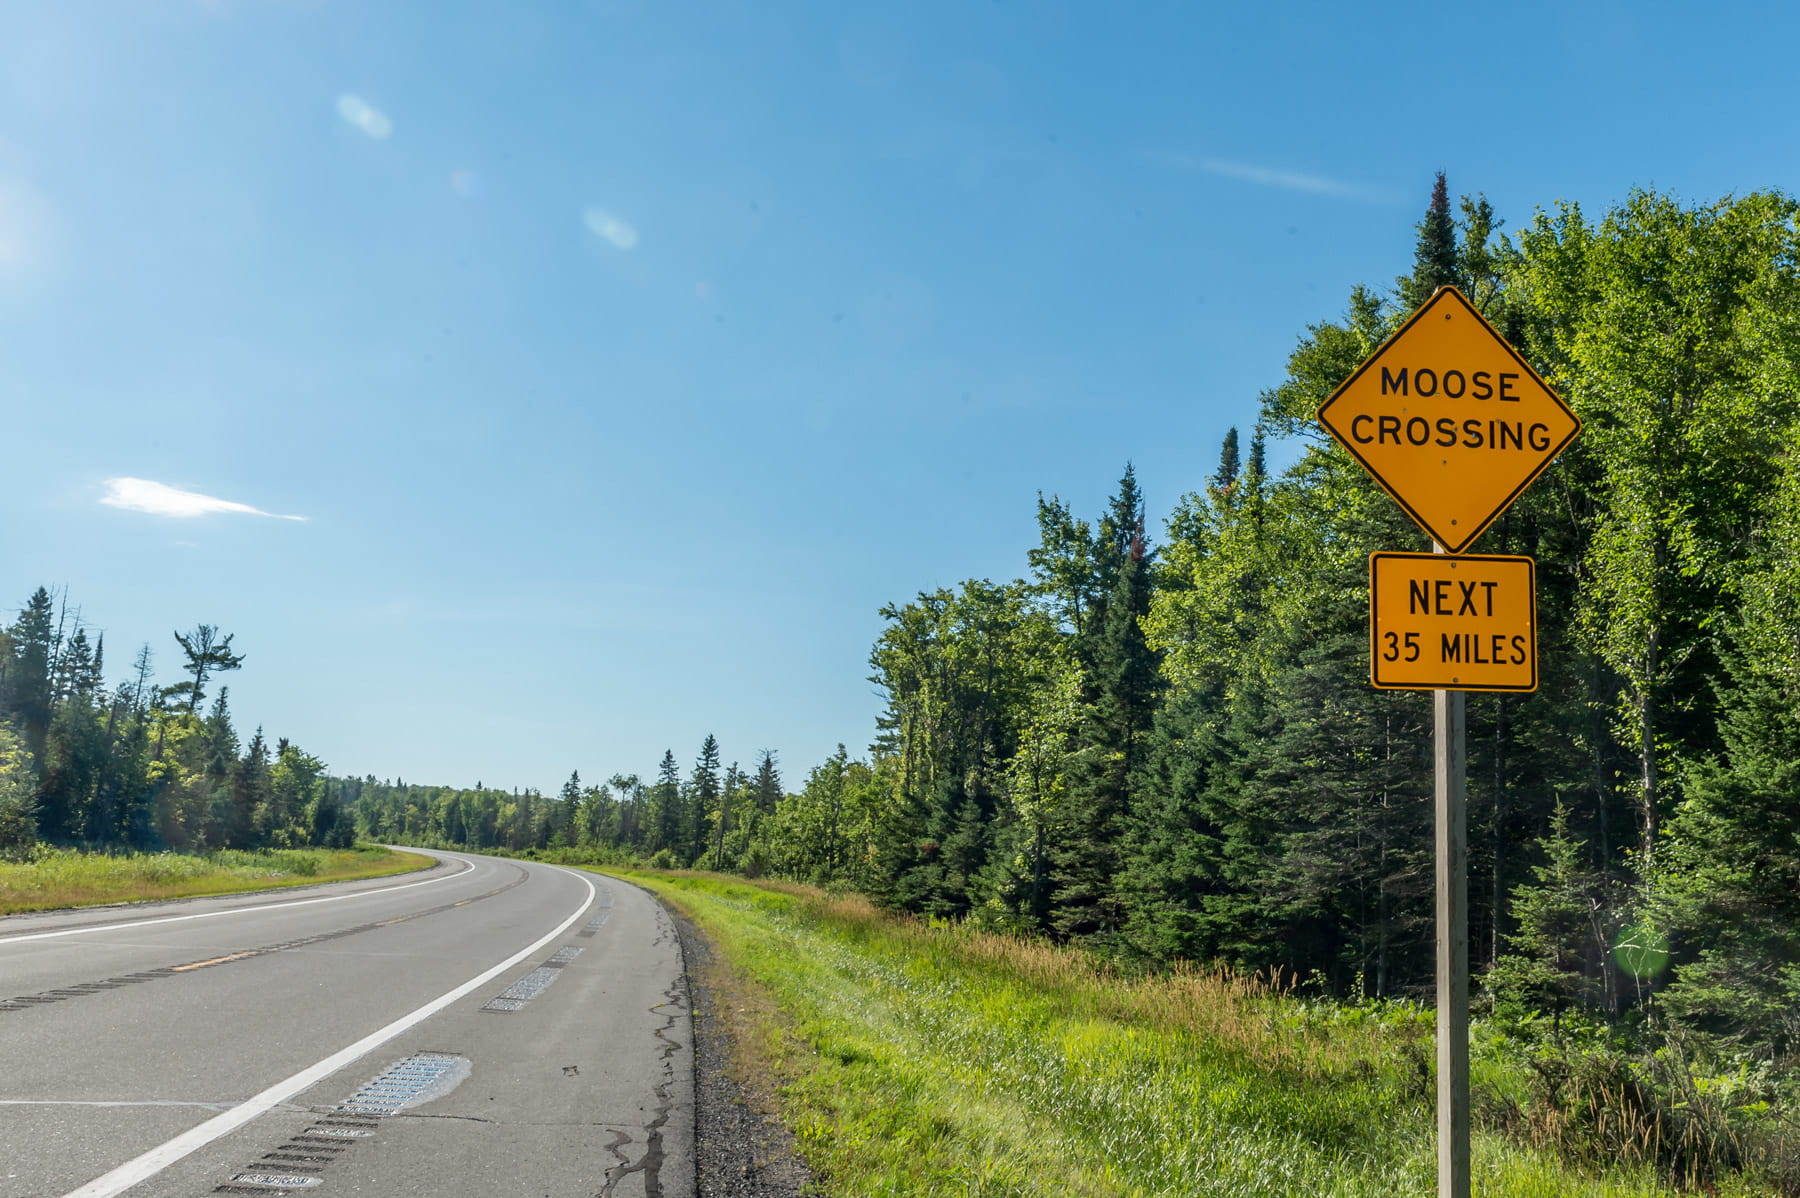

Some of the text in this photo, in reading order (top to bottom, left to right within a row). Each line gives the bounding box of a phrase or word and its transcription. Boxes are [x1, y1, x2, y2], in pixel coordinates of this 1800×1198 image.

[1381, 366, 1521, 402] MOOSE
[1351, 414, 1551, 452] CROSSING
[1409, 579, 1499, 617] NEXT
[1383, 631, 1527, 666] 35 MILES
